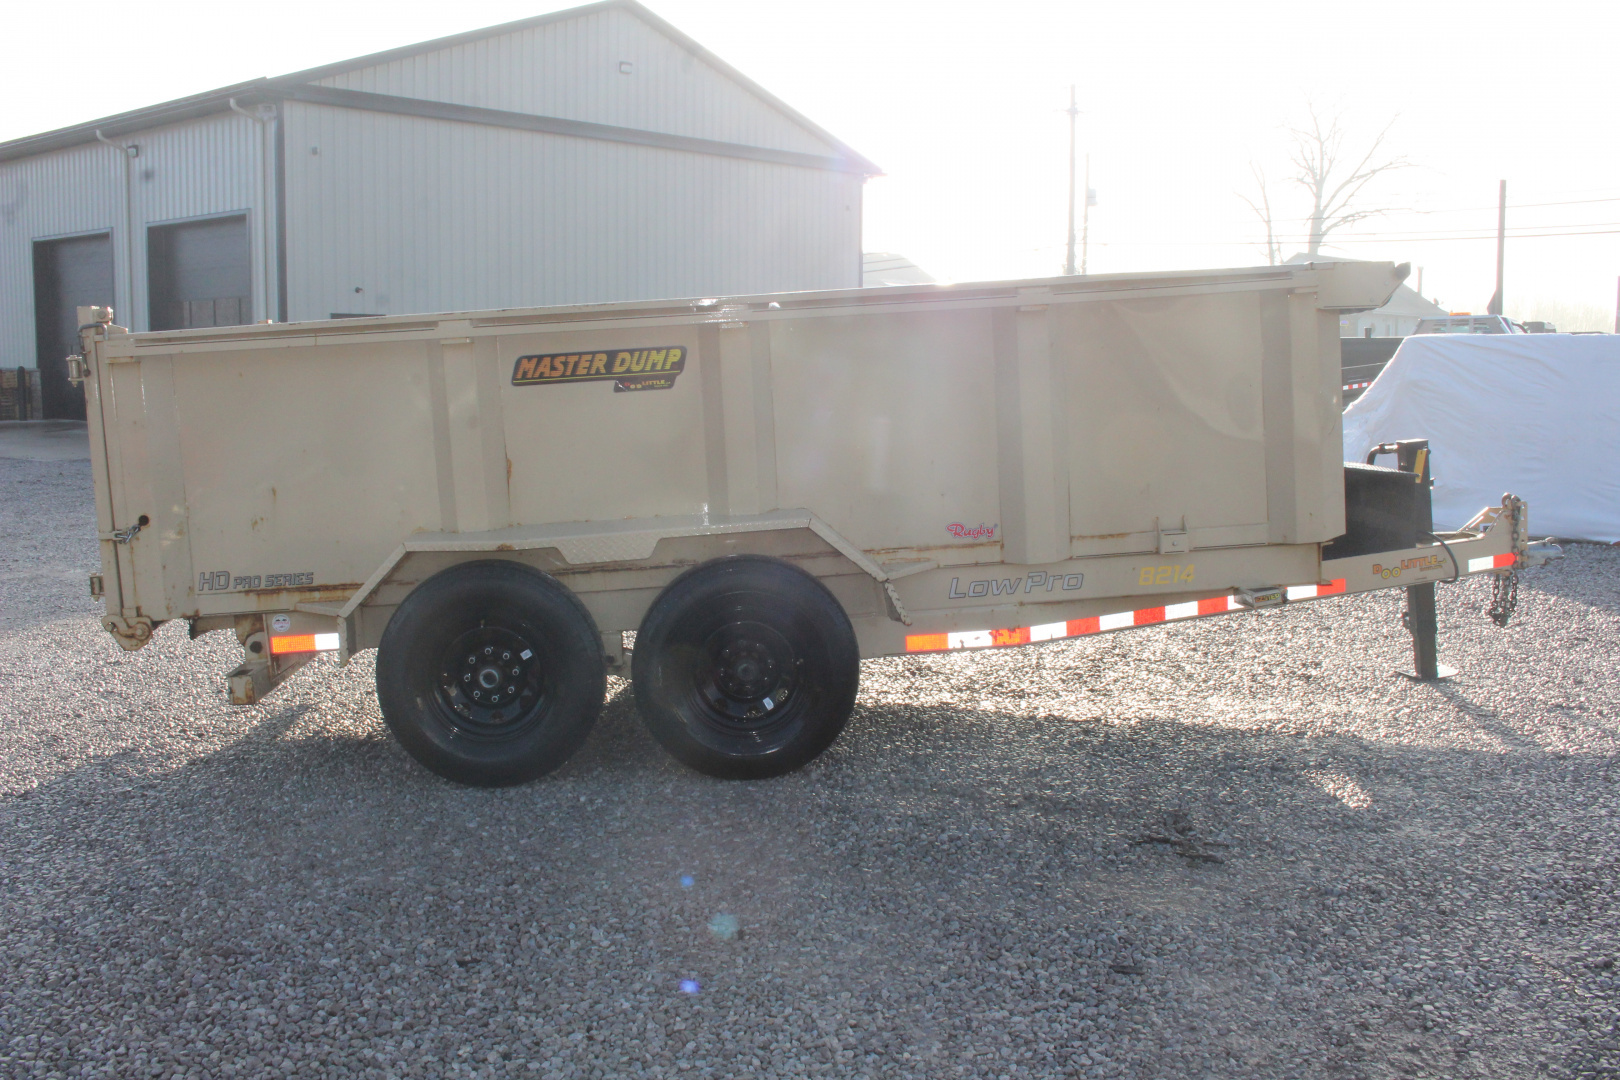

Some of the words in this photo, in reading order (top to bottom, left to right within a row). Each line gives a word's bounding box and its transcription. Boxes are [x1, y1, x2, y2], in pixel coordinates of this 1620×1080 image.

[515, 353, 608, 379] MASTER
[611, 348, 682, 373] DUMP
[946, 523, 995, 539] Rugby
[1372, 554, 1438, 579] DOOLITTLE
[198, 570, 231, 591] HD
[233, 575, 261, 589] PRO
[264, 572, 314, 588] SERIES
